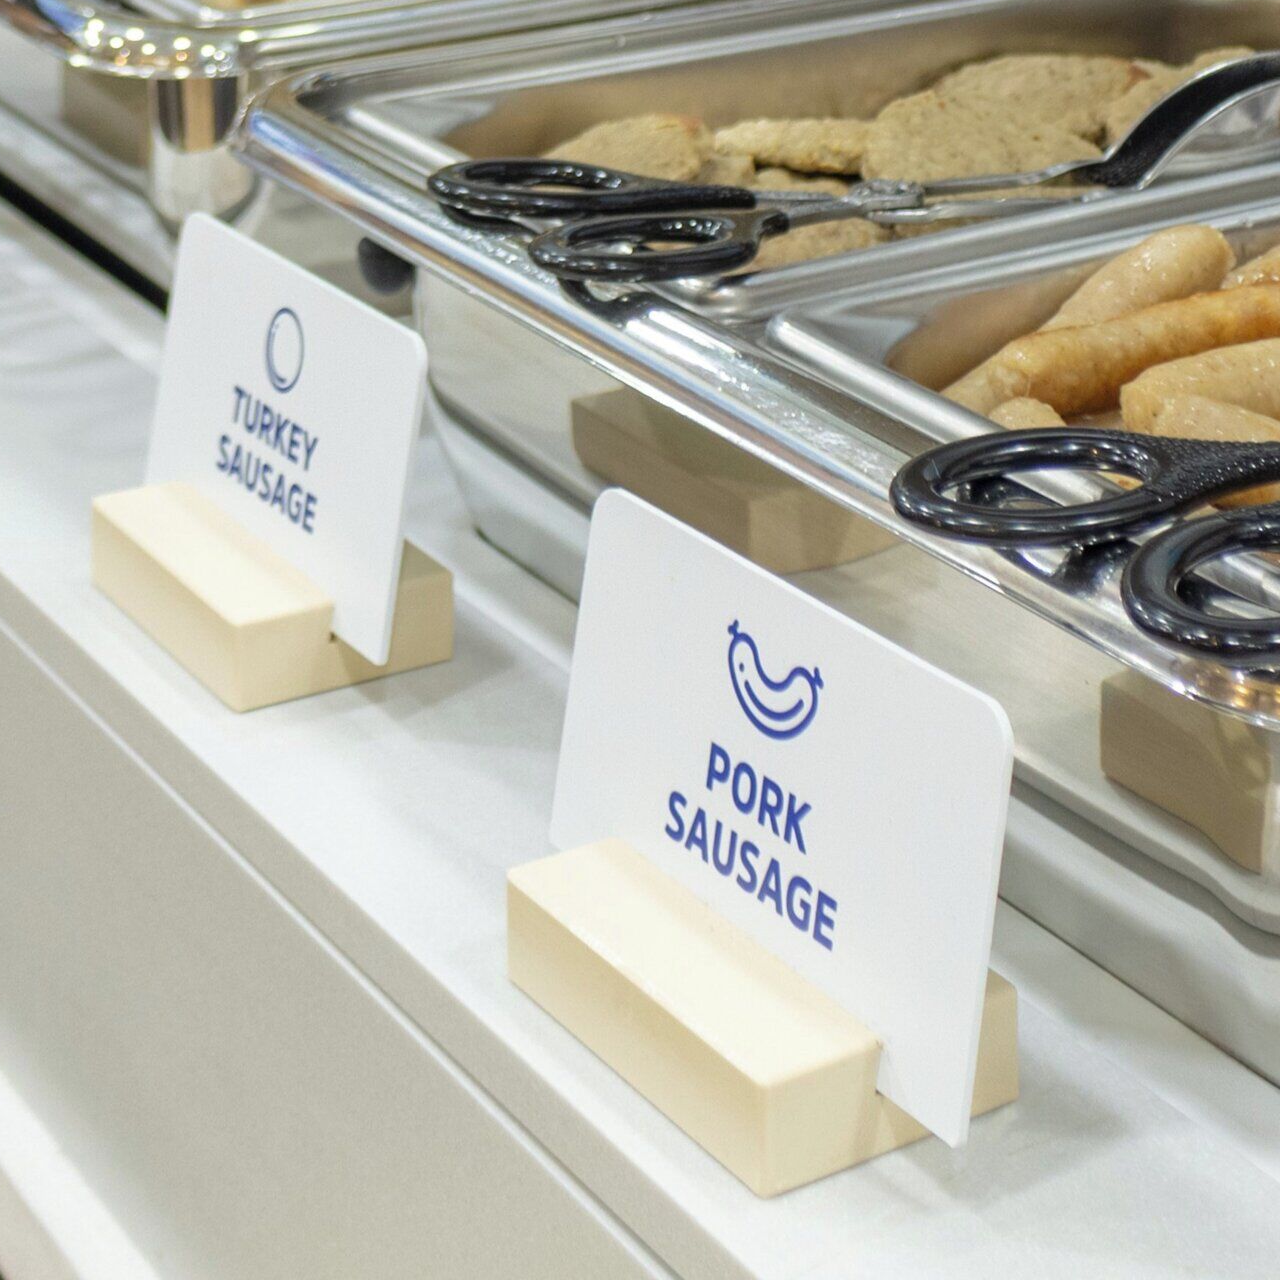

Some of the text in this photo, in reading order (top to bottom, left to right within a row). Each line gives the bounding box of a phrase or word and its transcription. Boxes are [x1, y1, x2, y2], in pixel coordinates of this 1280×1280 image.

[232, 385, 318, 472] TURKEY
[216, 435, 317, 533] SAUSAGE
[706, 742, 812, 854] PORK
[664, 791, 838, 951] SAUSAGE
